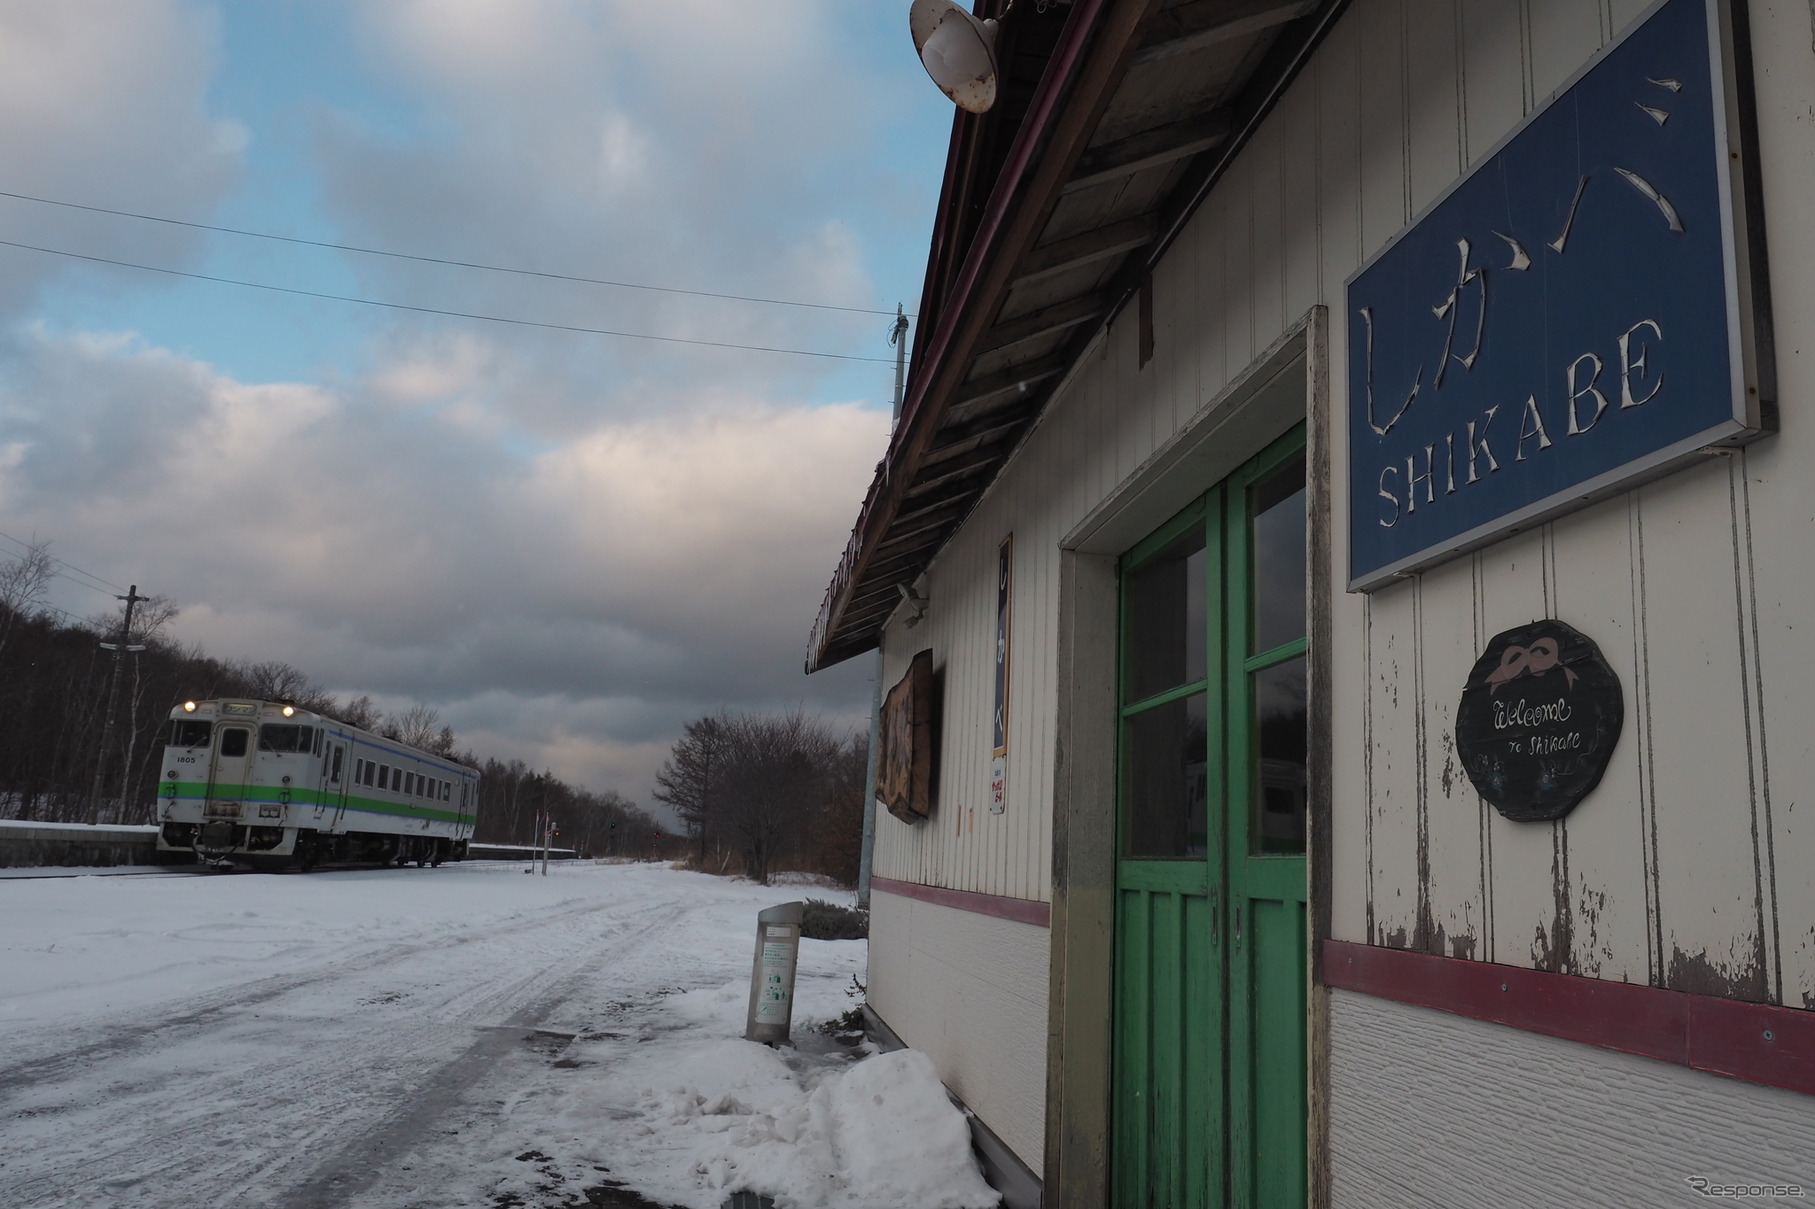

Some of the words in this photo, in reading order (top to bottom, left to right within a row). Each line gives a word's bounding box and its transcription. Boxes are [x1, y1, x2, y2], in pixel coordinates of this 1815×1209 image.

[1359, 76, 1684, 436] しかべ
[1379, 318, 1664, 528] SHIKABE
[995, 558, 1008, 732] しかべ
[1493, 698, 1571, 729] Welcome
